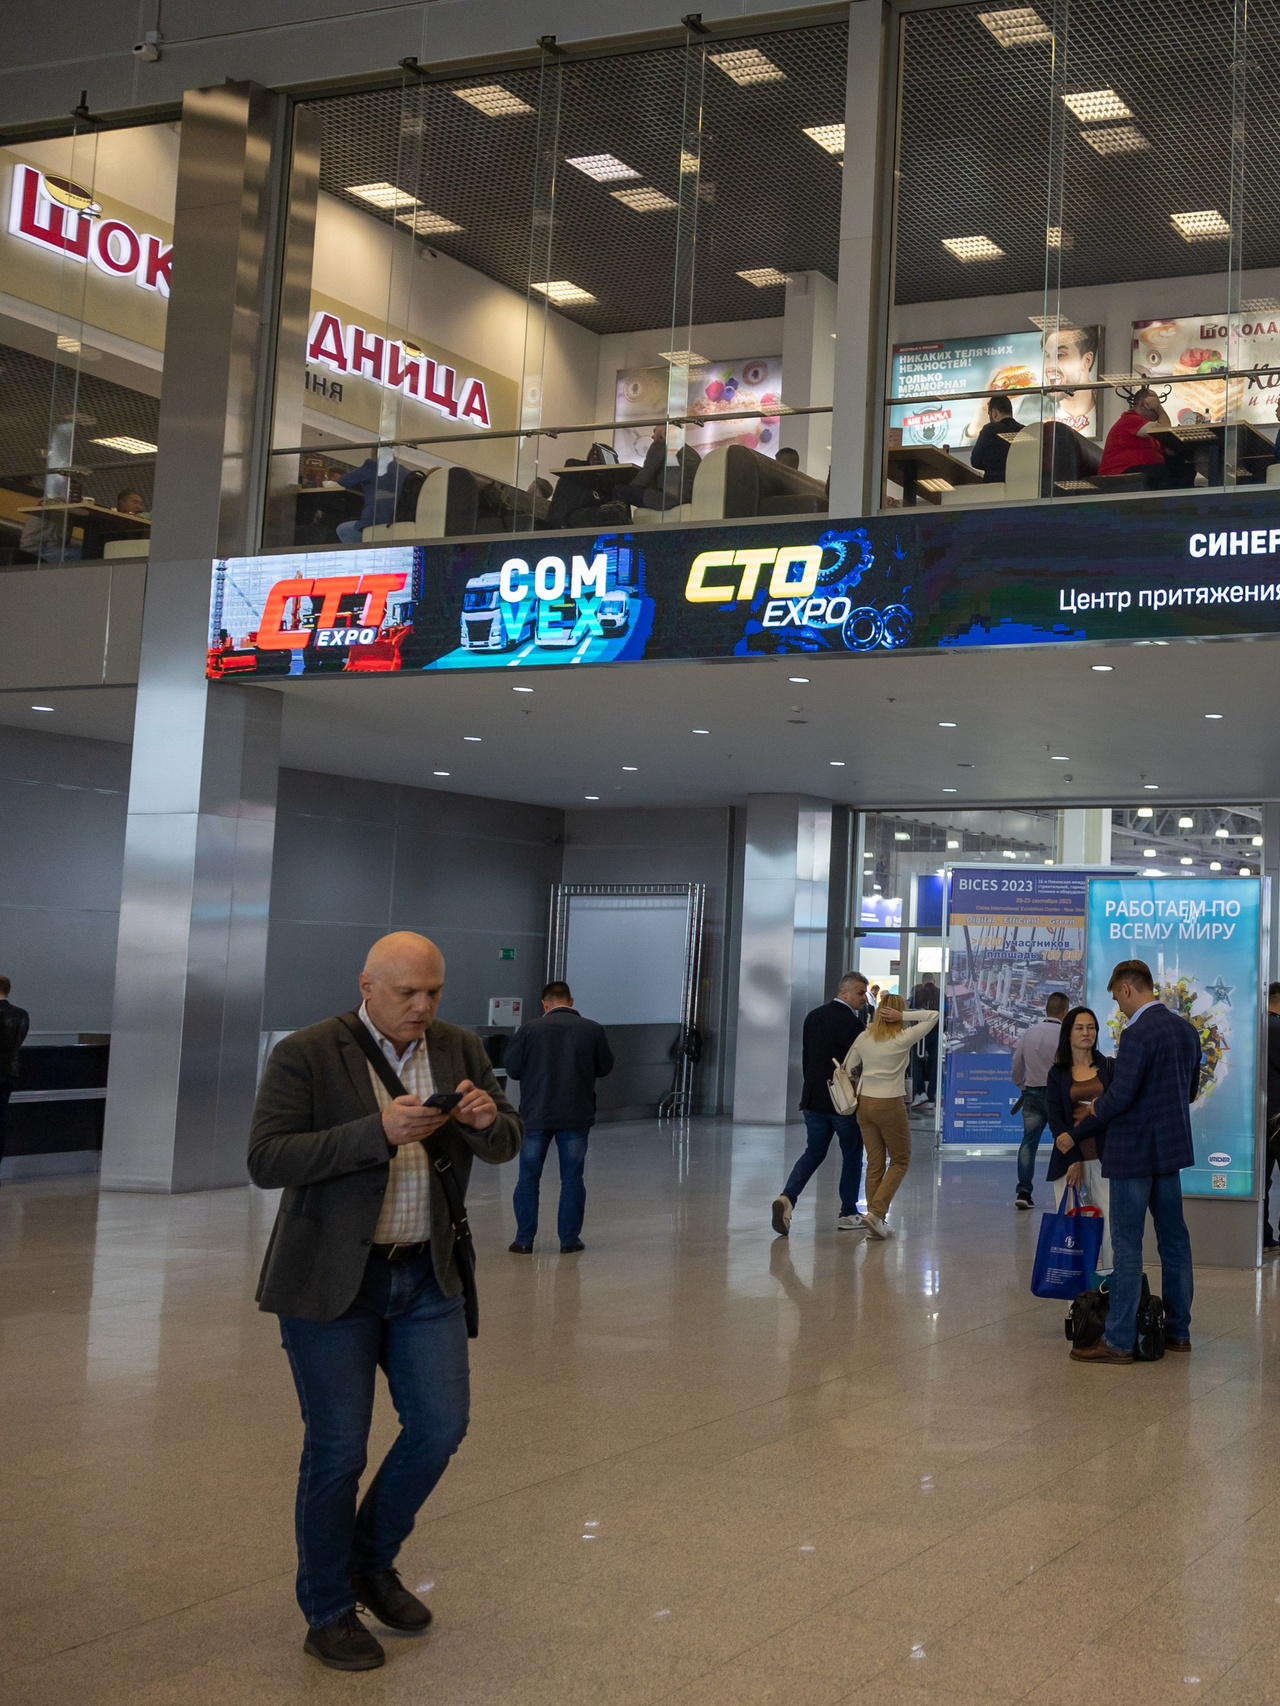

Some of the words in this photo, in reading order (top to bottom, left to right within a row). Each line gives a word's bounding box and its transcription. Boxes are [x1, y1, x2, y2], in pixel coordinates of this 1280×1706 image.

[899, 351, 952, 364] НИКАКИХ
[954, 345, 1013, 358] ТЕЛЯЧЬИХ
[899, 358, 972, 374] НЕЖНОСТЕЙ!
[898, 372, 943, 385] ТОЛЬКО
[898, 379, 967, 394] МРАМОРНАЯ
[499, 553, 608, 603] COM
[1059, 588, 1131, 613] Центр
[256, 572, 408, 650] CTT
[499, 595, 605, 640] VEX
[762, 596, 852, 628] EXPO
[316, 628, 375, 646] EXPO
[959, 878, 998, 891] BICES
[1001, 879, 1033, 892] 2023
[1105, 900, 1206, 917] РАБОТАЕМ
[1211, 900, 1241, 917] ПО
[965, 916, 995, 924] Digital
[1003, 916, 1040, 924] Efficient
[1109, 923, 1174, 940] ВСЕМУ
[1178, 923, 1236, 940] МИРУ
[1004, 939, 1070, 949] участников
[986, 951, 1038, 961] площадь
